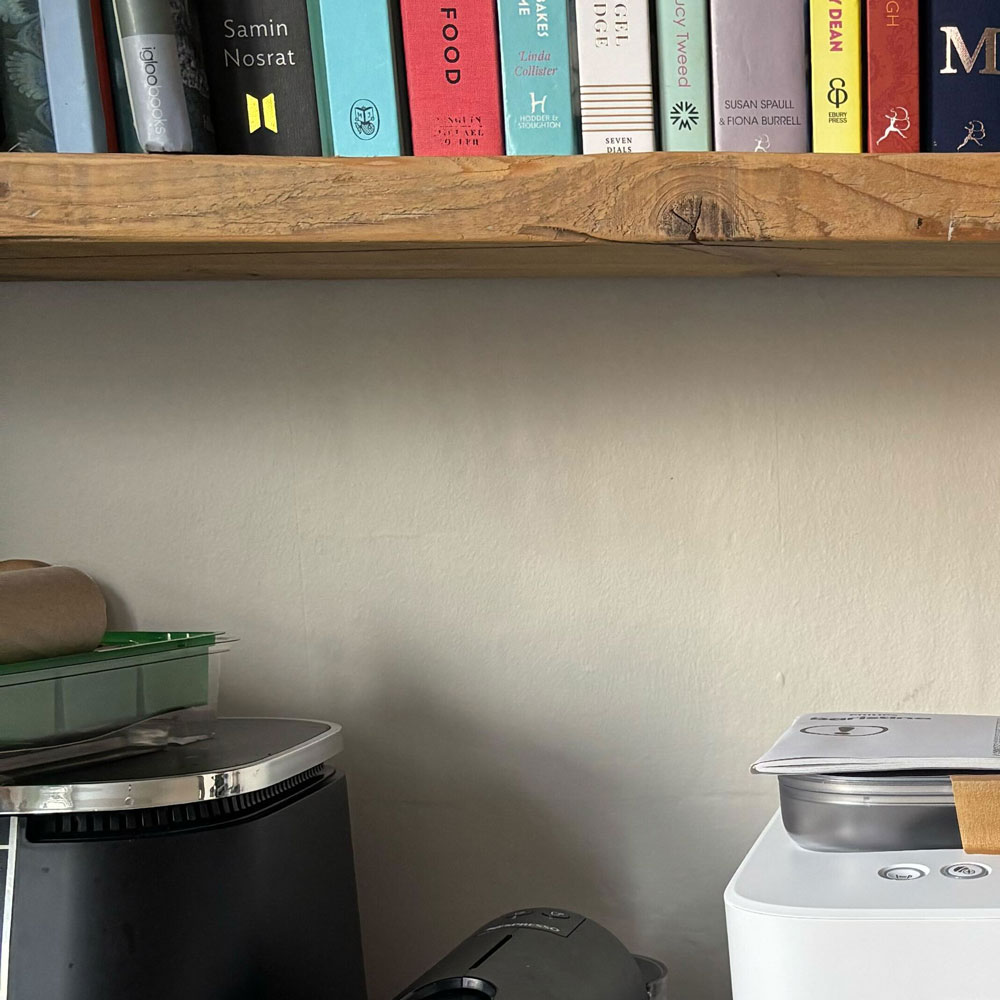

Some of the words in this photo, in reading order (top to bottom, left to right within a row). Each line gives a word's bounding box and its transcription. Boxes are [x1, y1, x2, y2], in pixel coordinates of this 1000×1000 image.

[536, 0, 549, 37] AKES
[224, 19, 288, 38] Samin
[829, 8, 843, 52] DEAN
[440, 7, 461, 84] FOOD
[224, 49, 296, 67] Nosrat
[519, 50, 551, 62] Linda
[676, 32, 691, 88] Tweed
[514, 65, 557, 77] Collister
[140, 46, 167, 135] igloobooks
[724, 100, 758, 110] SUSAN
[760, 100, 795, 110] SPAULL
[518, 121, 561, 129] STOUGHTON
[520, 114, 551, 122] HODDER
[719, 117, 726, 126] &
[727, 116, 759, 126] FIONA
[762, 116, 802, 126] BURRELL
